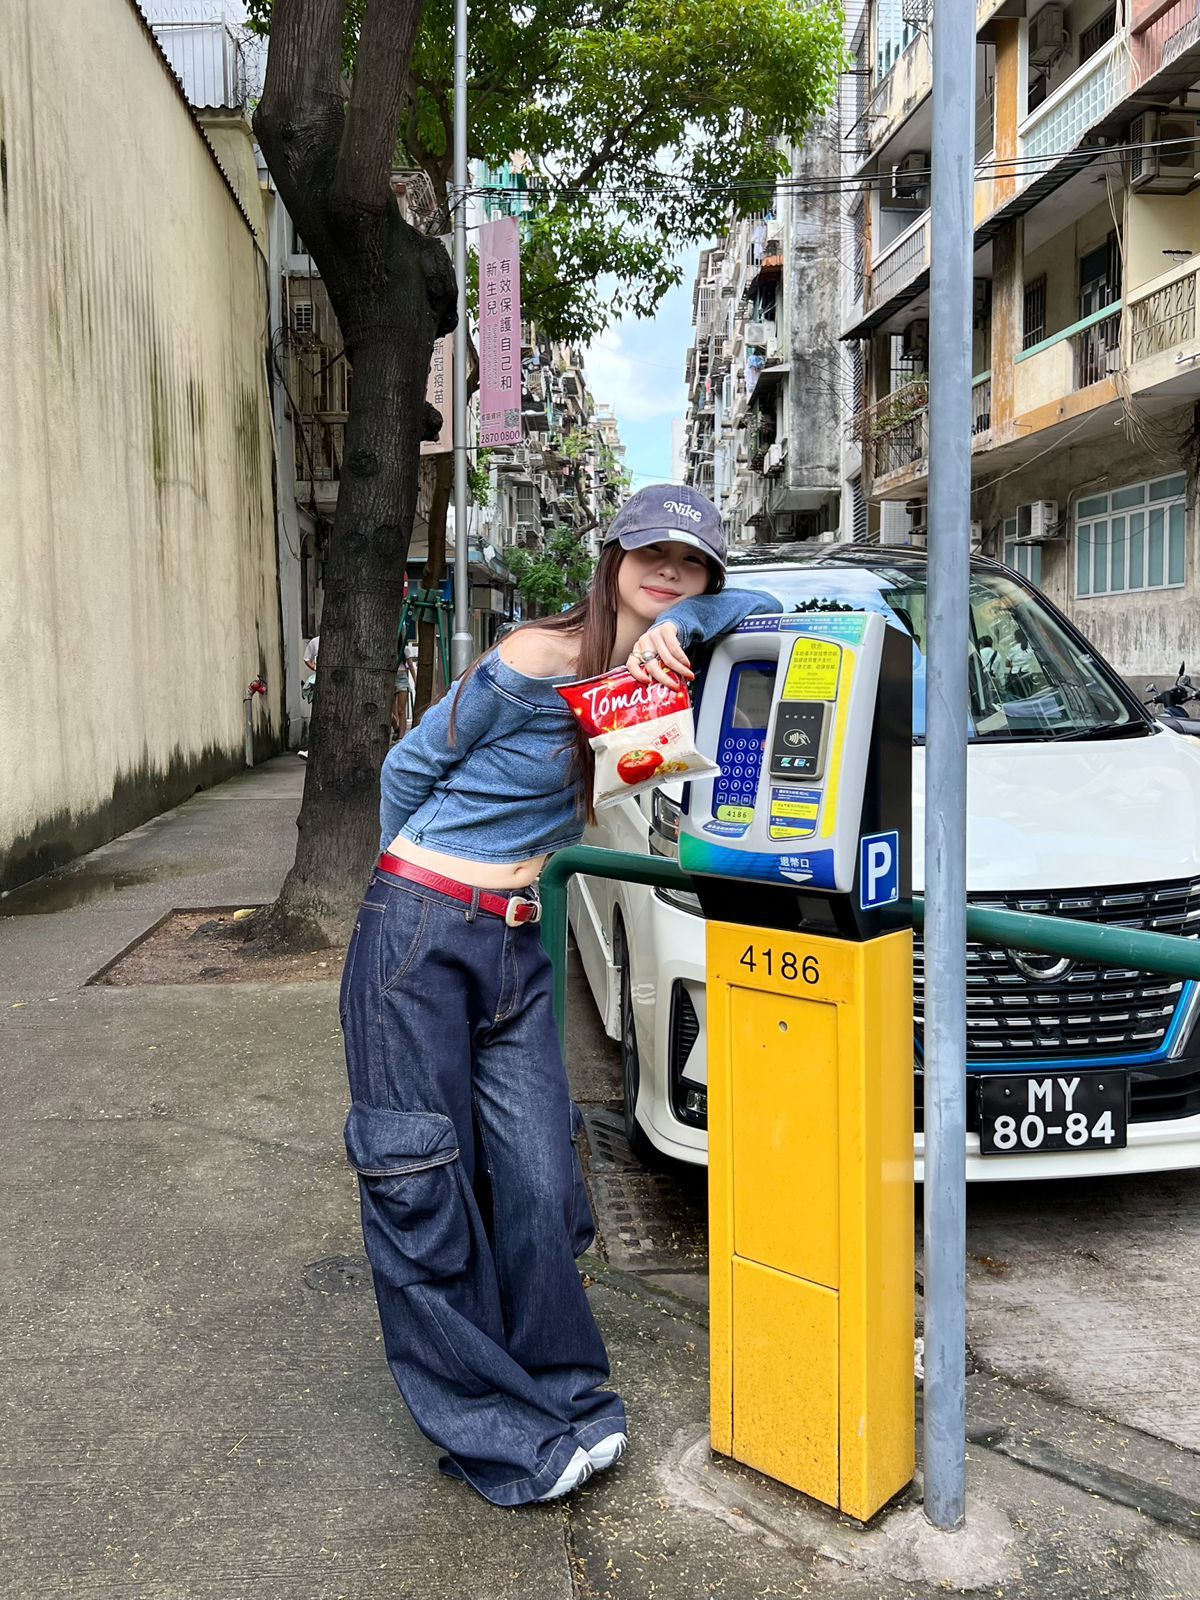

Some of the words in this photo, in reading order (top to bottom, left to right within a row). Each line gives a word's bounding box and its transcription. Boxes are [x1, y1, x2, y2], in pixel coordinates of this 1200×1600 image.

[486, 261, 498, 317] 新生兒
[500, 259, 512, 391] 有效保護自己和
[481, 433, 499, 443] 2870
[500, 430, 520, 440] 0800
[663, 501, 702, 523] Nike
[726, 810, 748, 819] 4186
[780, 856, 810, 868] 退幣口
[868, 841, 892, 901] P
[739, 944, 820, 985] 4186
[1027, 1077, 1081, 1113] MY
[992, 1110, 1116, 1150] 80-84
